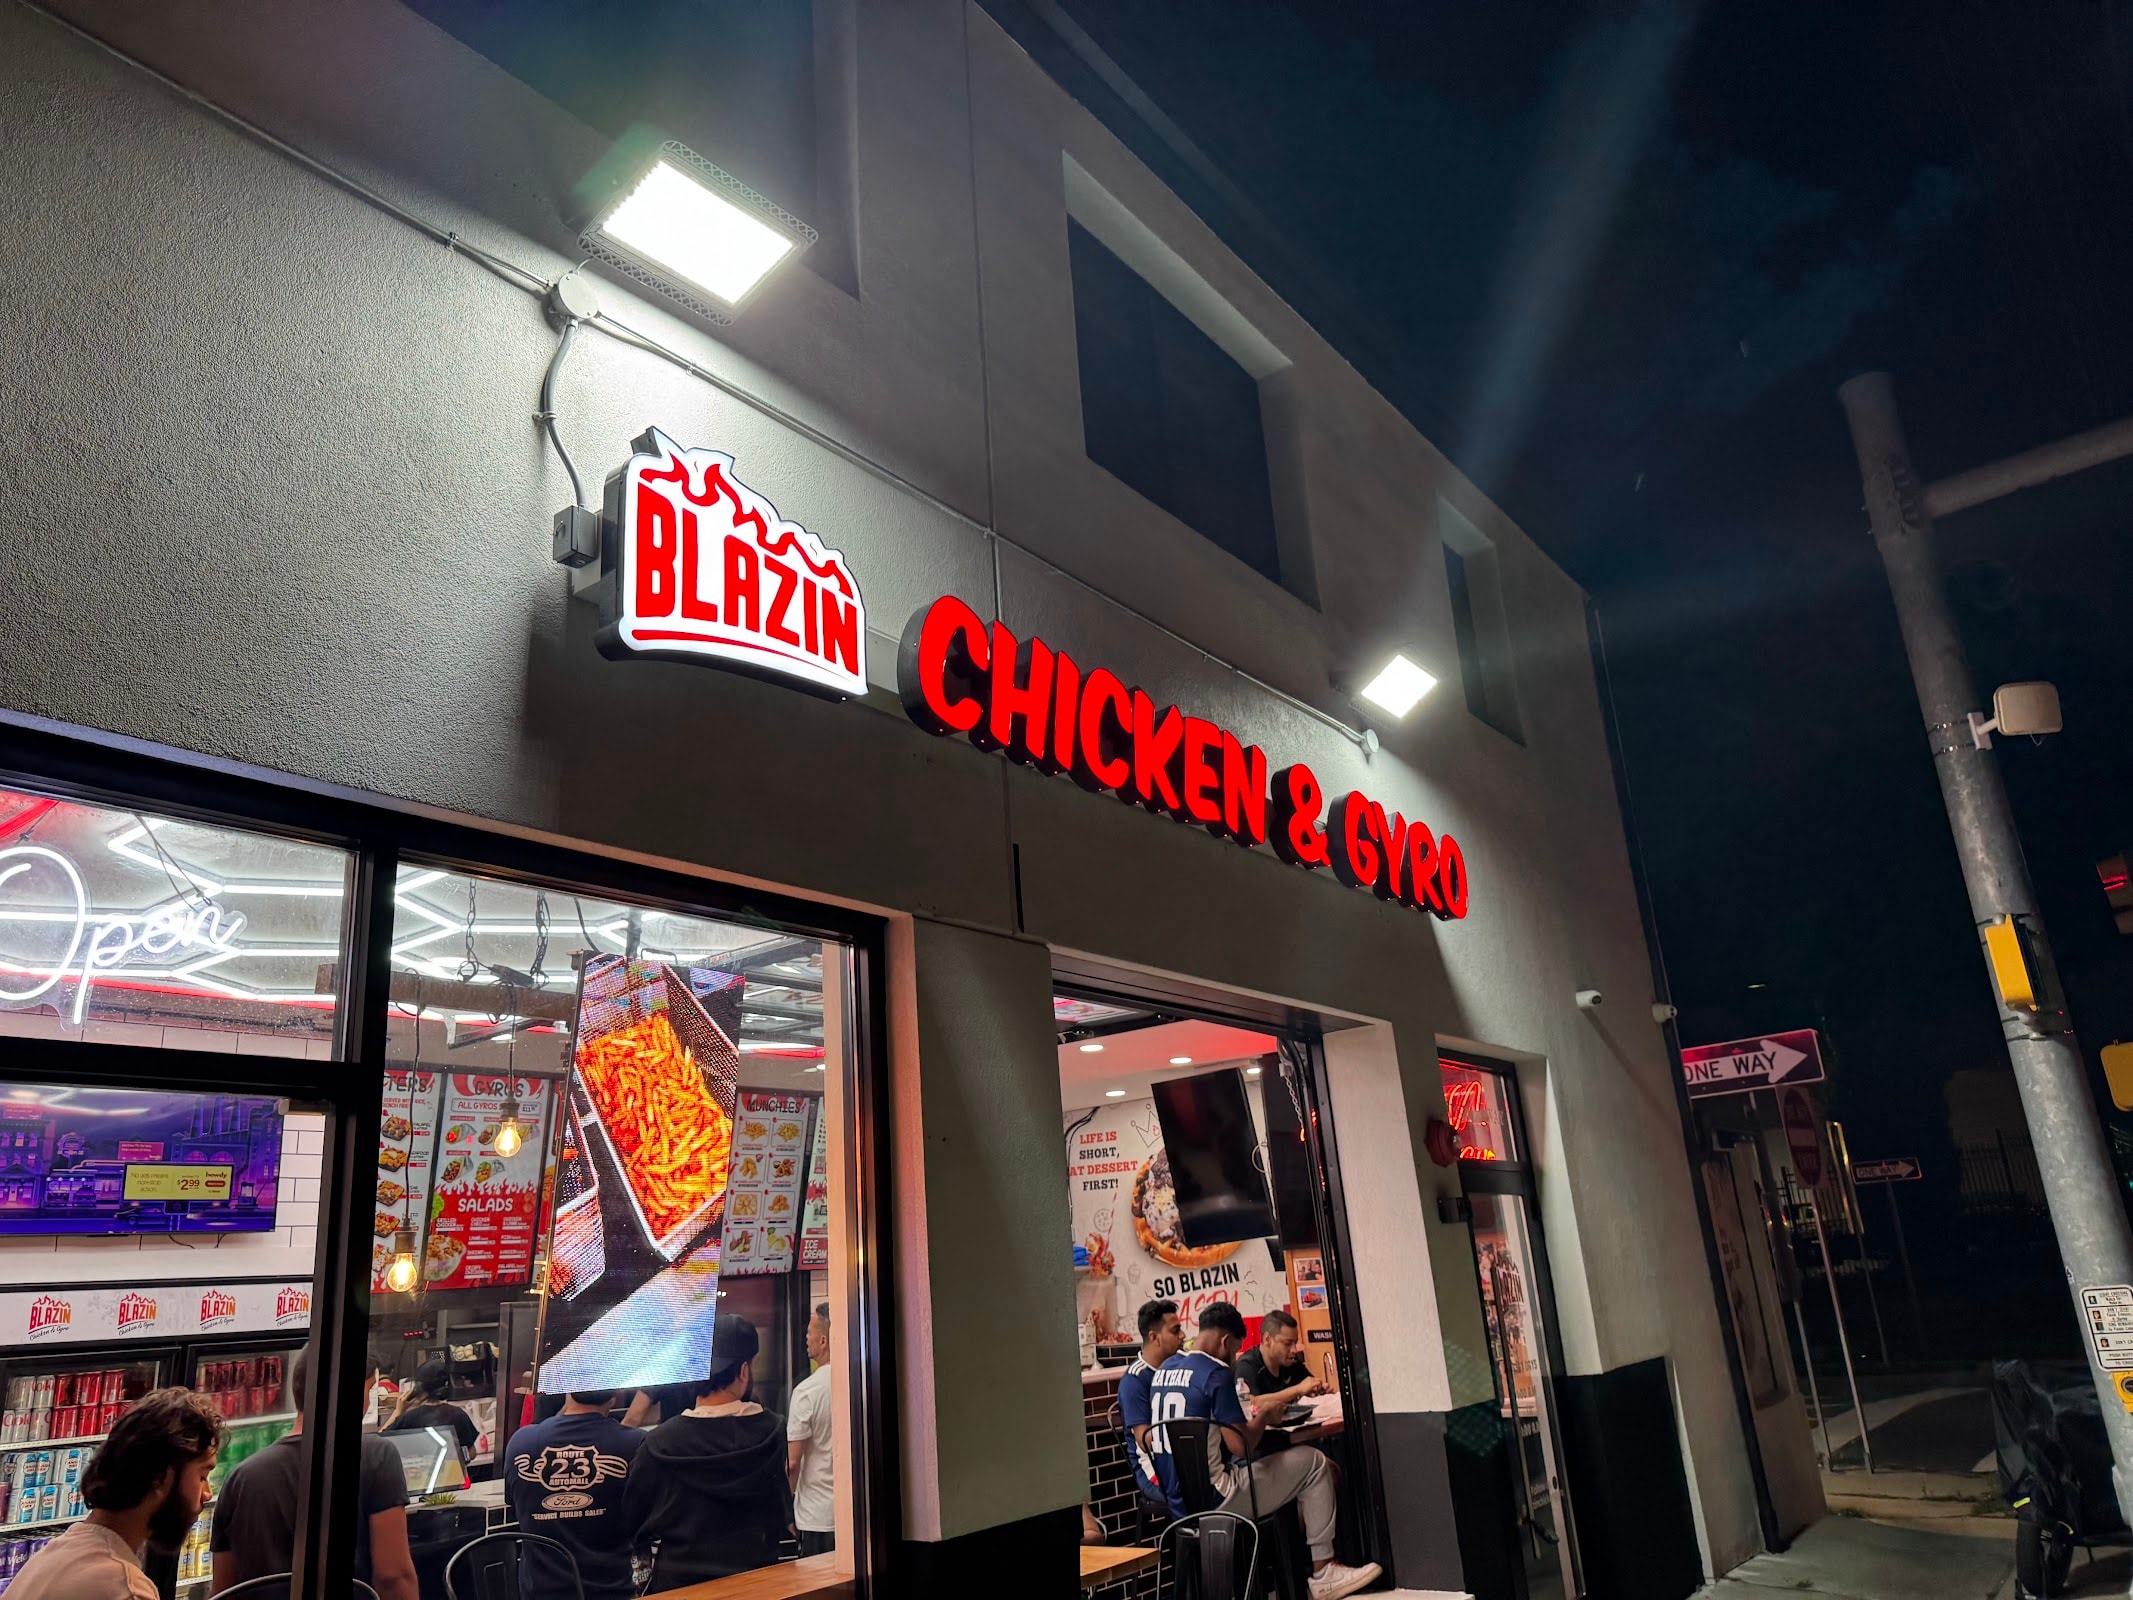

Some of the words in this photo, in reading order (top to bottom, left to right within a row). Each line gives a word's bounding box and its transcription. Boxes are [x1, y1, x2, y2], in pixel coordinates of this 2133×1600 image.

[636, 481, 859, 676] BLAZIN
[917, 595, 1267, 848] CHICKEN
[1286, 763, 1330, 868] &
[1342, 790, 1468, 920] GYRO
[0, 845, 244, 1025] Open
[1733, 1051, 1777, 1074] WAY
[458, 1102, 472, 1110] ALL
[746, 1099, 800, 1113] MUNCHIES
[1080, 1133, 1103, 1144] LIFE
[1106, 1131, 1117, 1141] IS
[1079, 1147, 1120, 1159] SHORT,
[1087, 1161, 1138, 1174] DESSERT
[1083, 1179, 1118, 1191] FIRST!
[458, 1198, 513, 1212] SALADS
[804, 1239, 818, 1248] ICE
[803, 1249, 828, 1259] CREAM
[1154, 1276, 1175, 1298] SO
[1179, 1262, 1239, 1293] BLAZIN
[118, 1303, 157, 1326] BLAZIN
[200, 1299, 236, 1322] BLAZIN
[276, 1296, 310, 1318] BLAZIN
[29, 1306, 71, 1330] BLAZIN
[550, 1458, 591, 1479] 23
[553, 1495, 581, 1506] Ford
